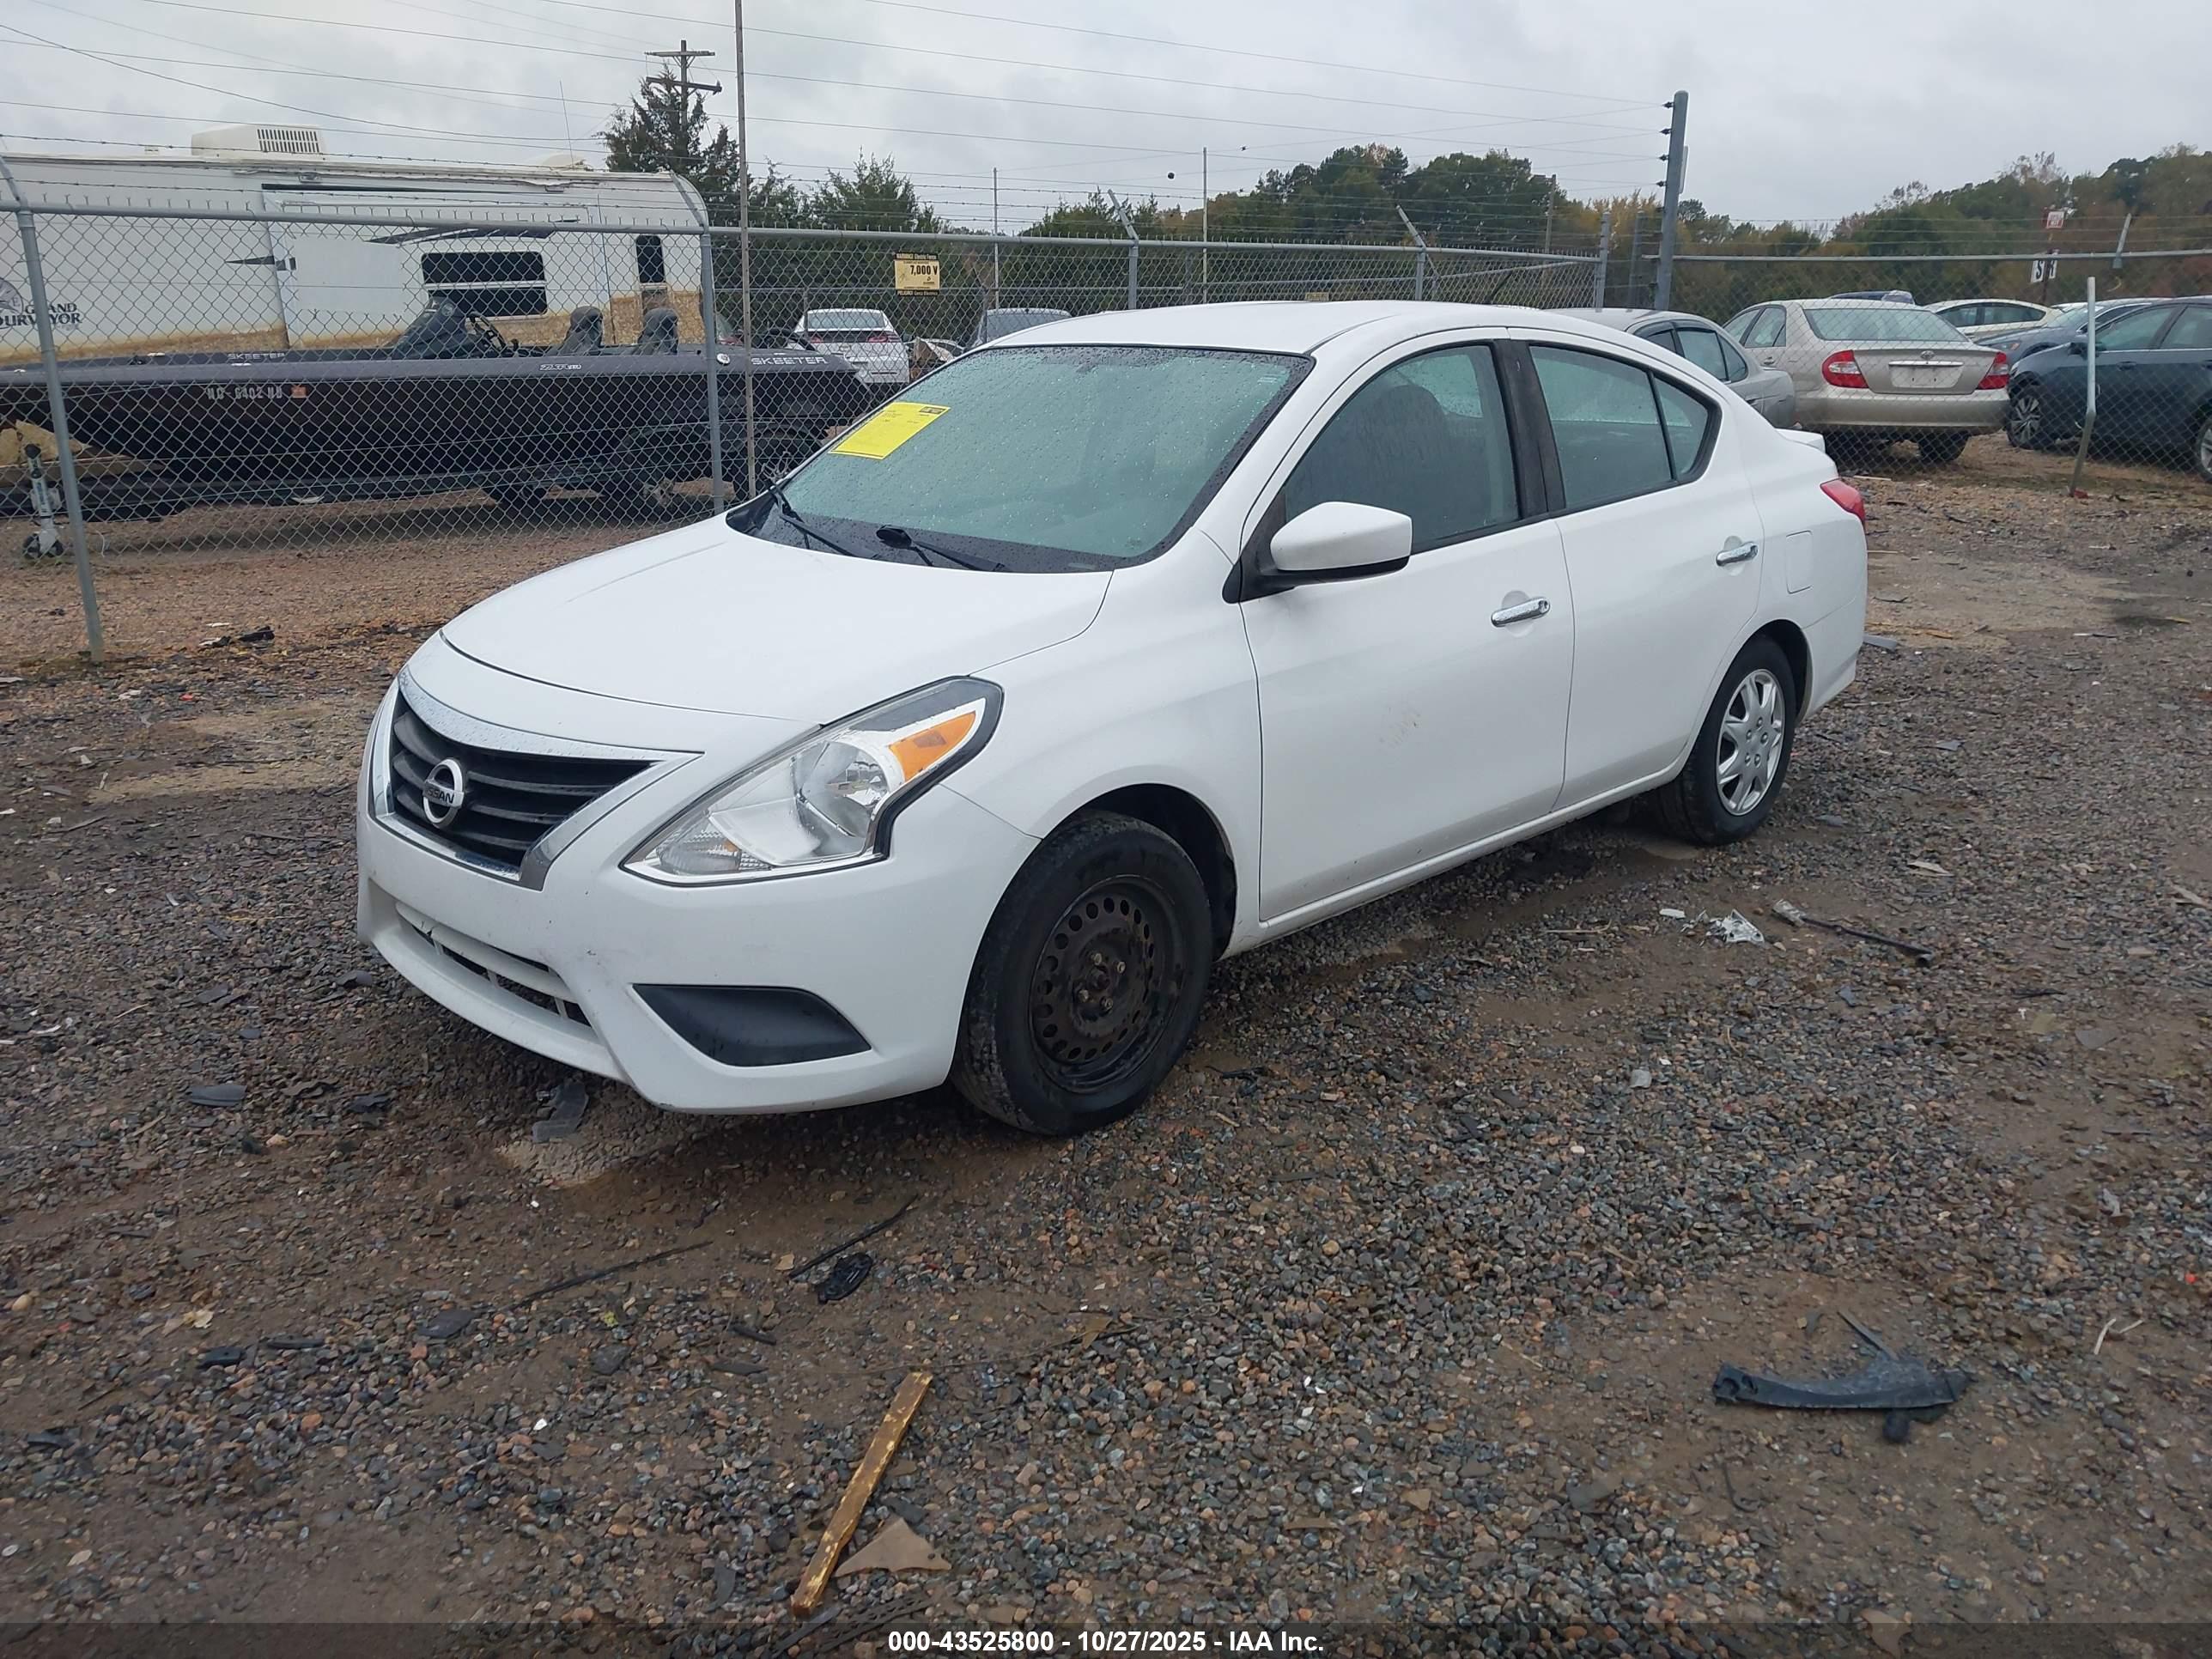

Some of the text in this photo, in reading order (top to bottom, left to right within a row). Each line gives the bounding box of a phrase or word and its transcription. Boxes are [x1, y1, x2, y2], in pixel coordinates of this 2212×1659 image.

[910, 264, 938, 276] 7,000 V
[25, 302, 77, 314] GAND
[750, 356, 828, 365] SKEETER
